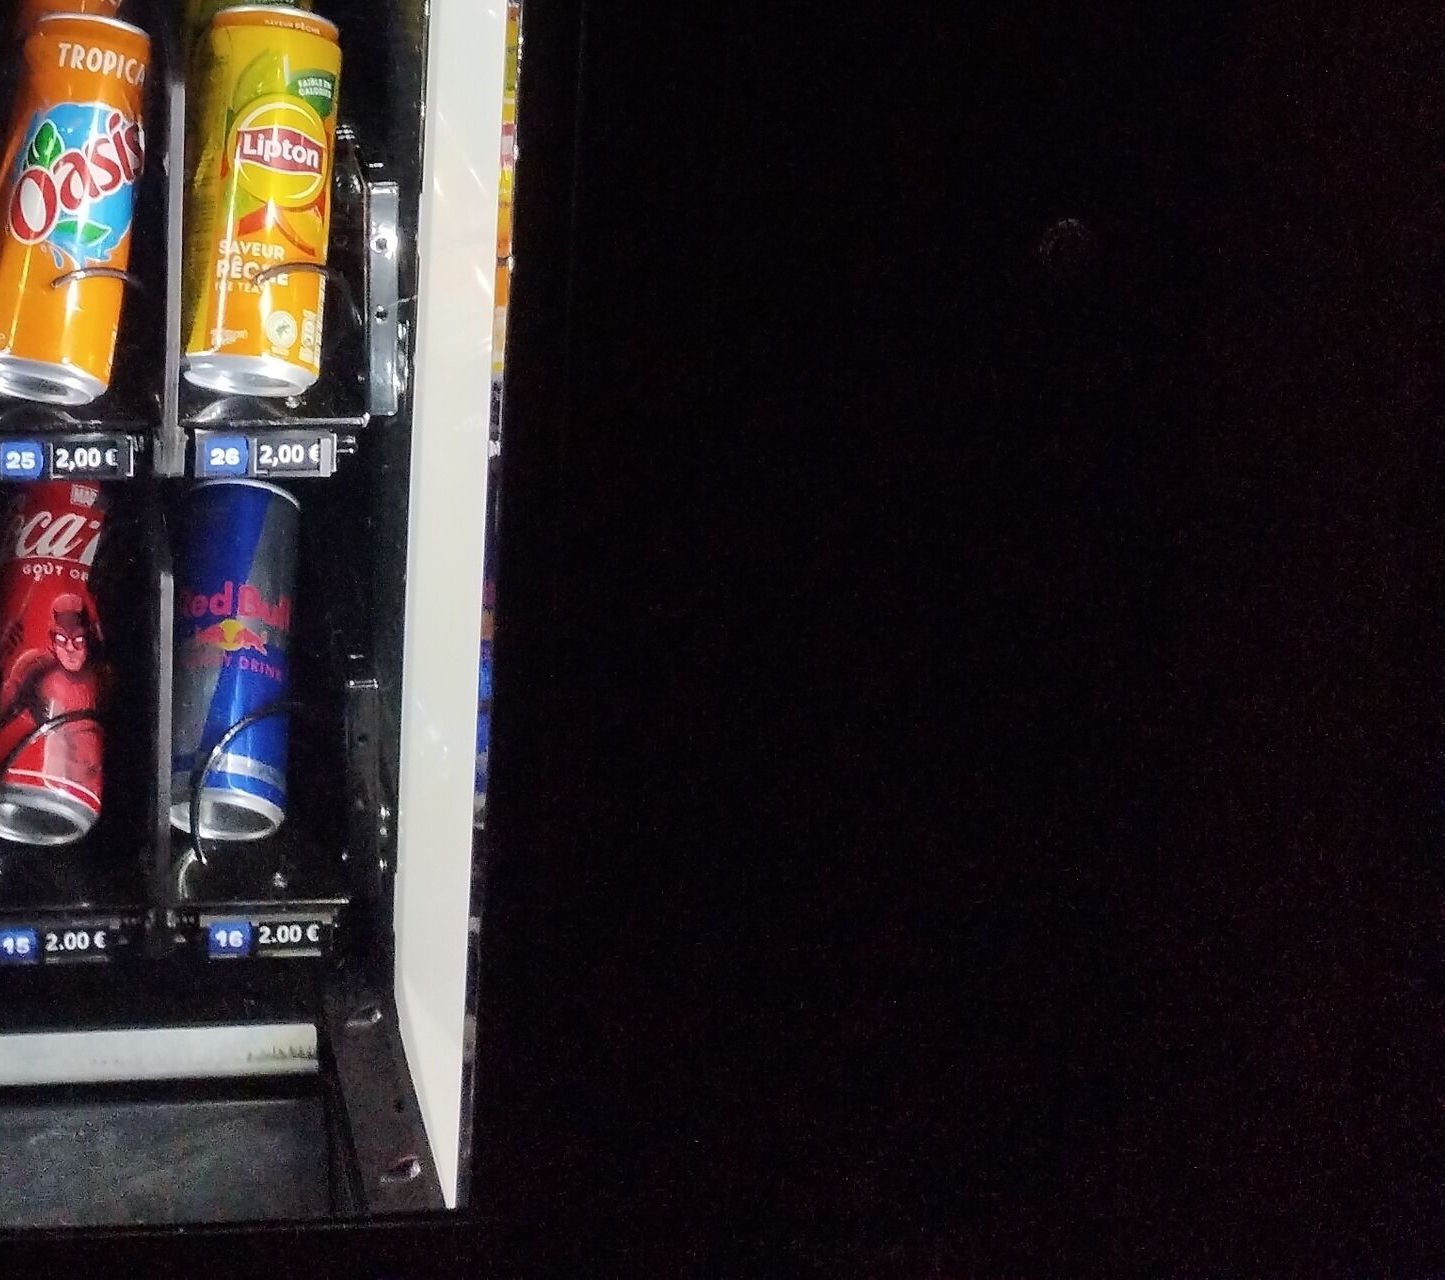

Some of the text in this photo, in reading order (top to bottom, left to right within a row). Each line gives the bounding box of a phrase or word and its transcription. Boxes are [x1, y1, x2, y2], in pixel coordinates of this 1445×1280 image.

[242, 132, 321, 170] Lipton
[13, 112, 145, 241] Oasis
[218, 239, 286, 261] SAVEUR
[5, 448, 119, 472] 25 2,00 €
[209, 447, 241, 467] 26
[259, 443, 305, 467] 2,00
[1, 936, 30, 956] 15
[93, 931, 106, 950] €
[214, 930, 244, 948] 16
[306, 925, 319, 943] €
